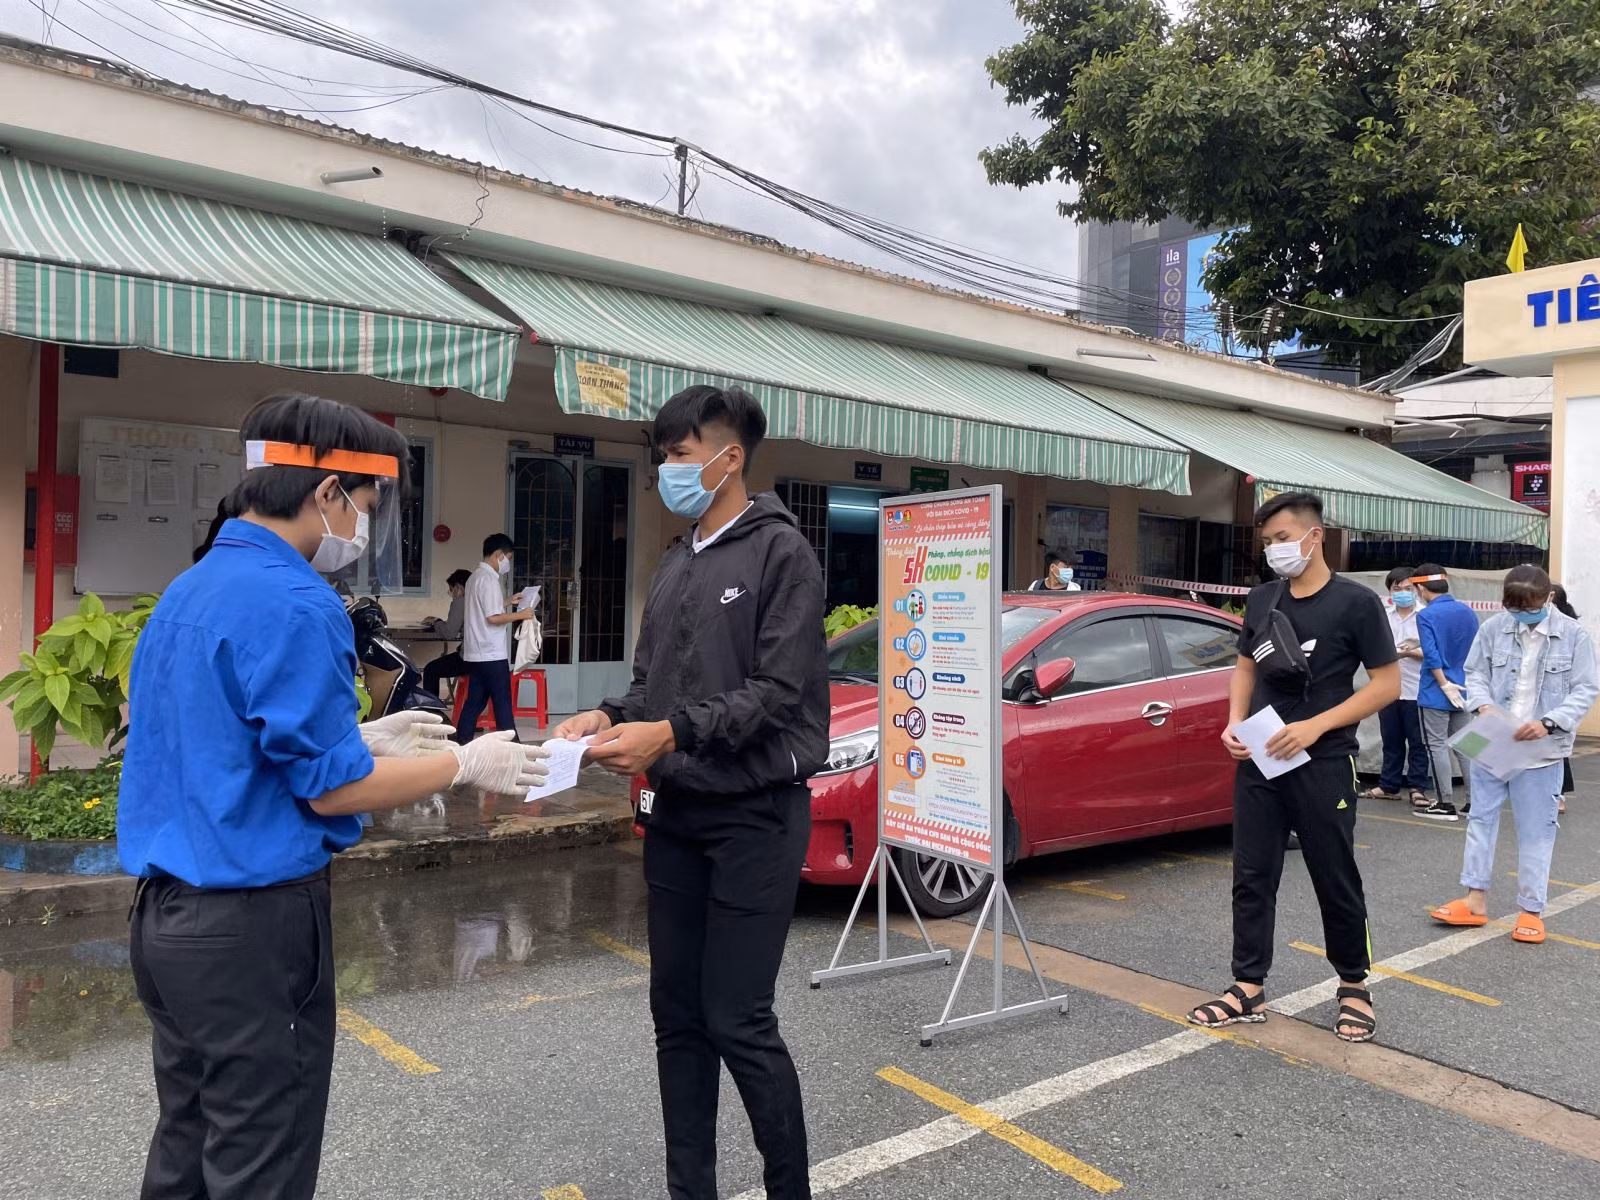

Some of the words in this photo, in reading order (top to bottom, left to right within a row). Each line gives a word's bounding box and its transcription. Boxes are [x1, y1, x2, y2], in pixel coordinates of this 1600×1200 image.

[1527, 273, 1600, 328] TIÊ
[1514, 464, 1552, 472] SHAR
[903, 546, 928, 584] 5K
[925, 563, 962, 582] COVID
[976, 562, 990, 581] 19
[724, 587, 739, 597] NIKE
[896, 600, 904, 611] 01
[896, 638, 904, 649] 02
[895, 676, 905, 688] 03
[895, 715, 904, 727] 04
[895, 753, 905, 766] 05
